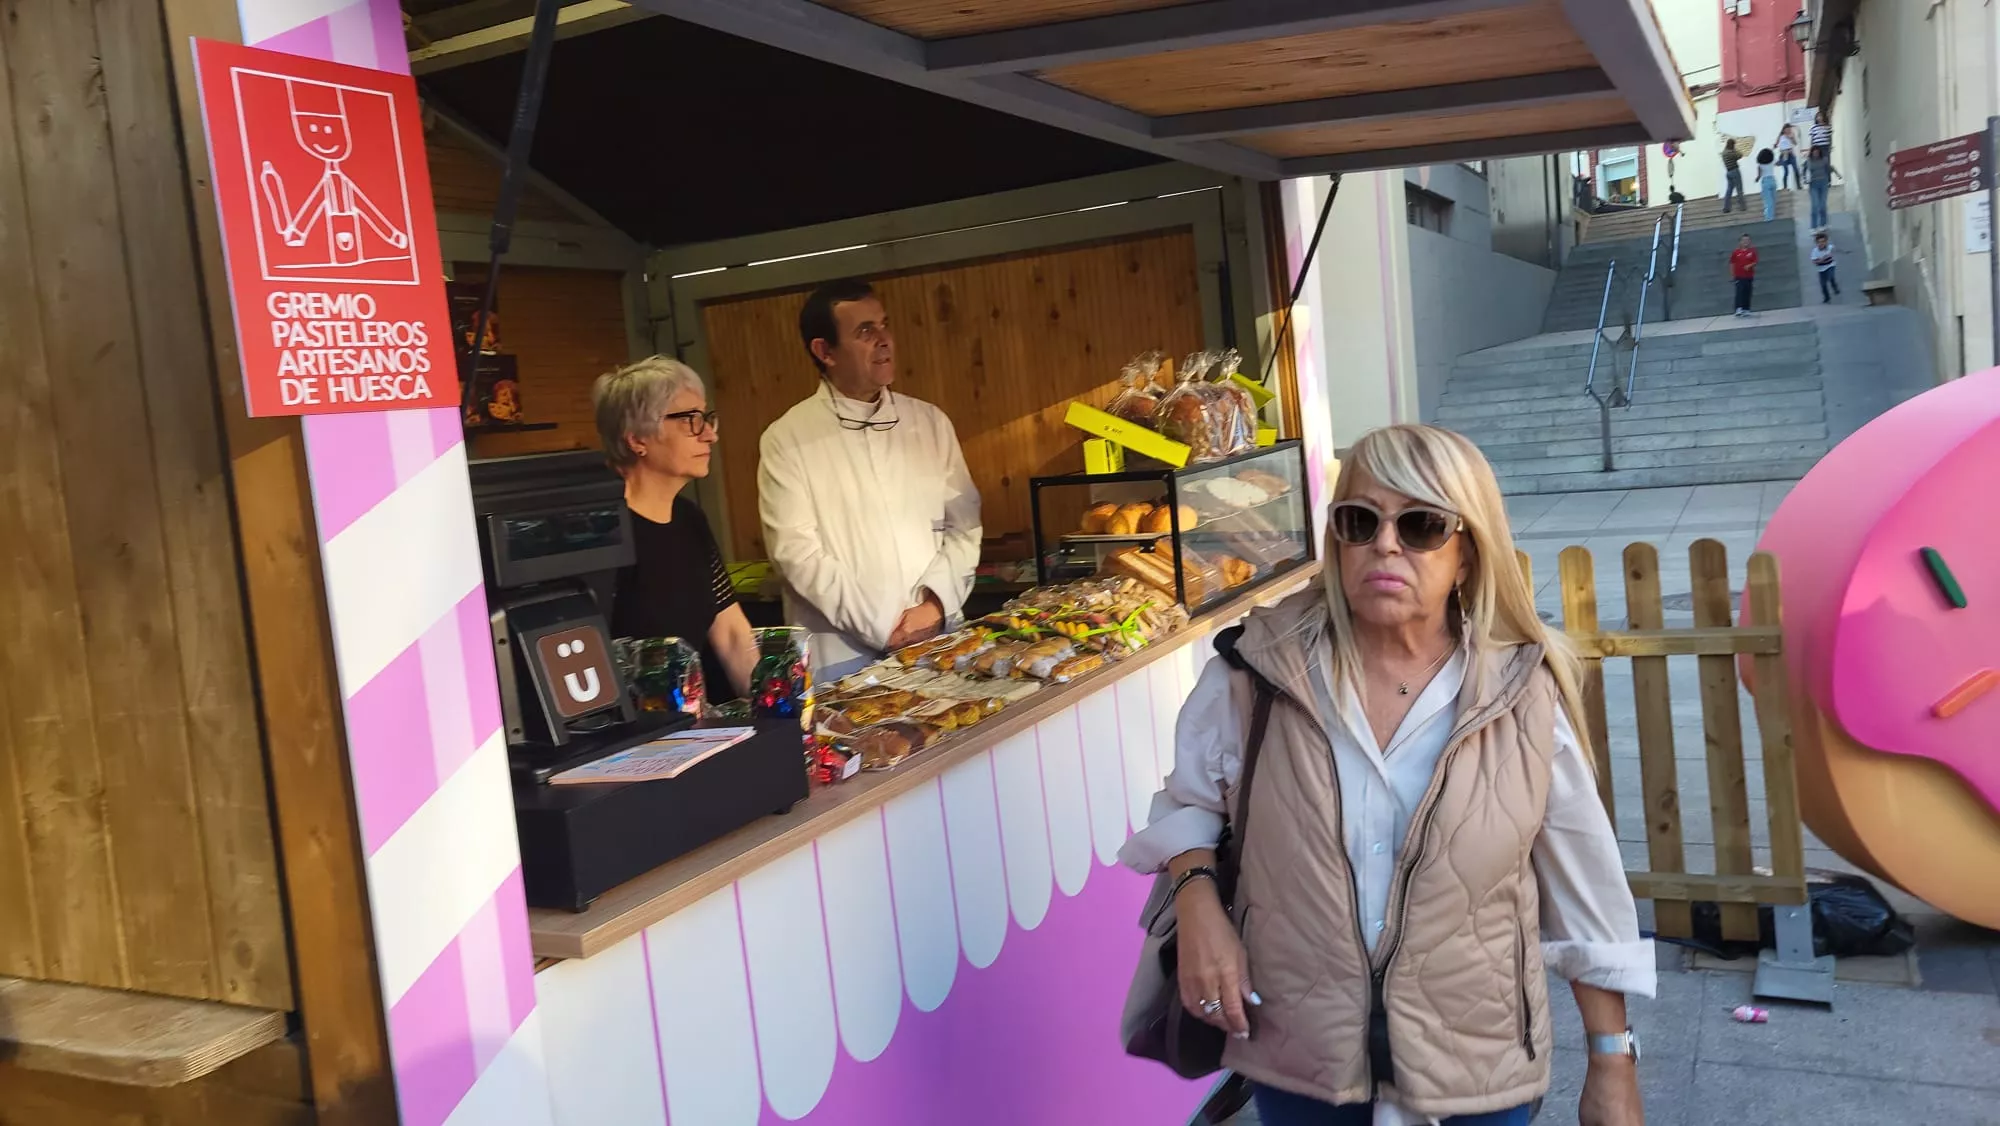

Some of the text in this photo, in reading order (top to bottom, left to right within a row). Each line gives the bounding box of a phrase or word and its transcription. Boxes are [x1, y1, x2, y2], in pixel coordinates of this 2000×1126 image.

[266, 291, 377, 319] GREMIO
[271, 320, 429, 347] PASTELEROS
[277, 348, 432, 376] ARTESANOS
[280, 374, 433, 406] DE HUESCA
